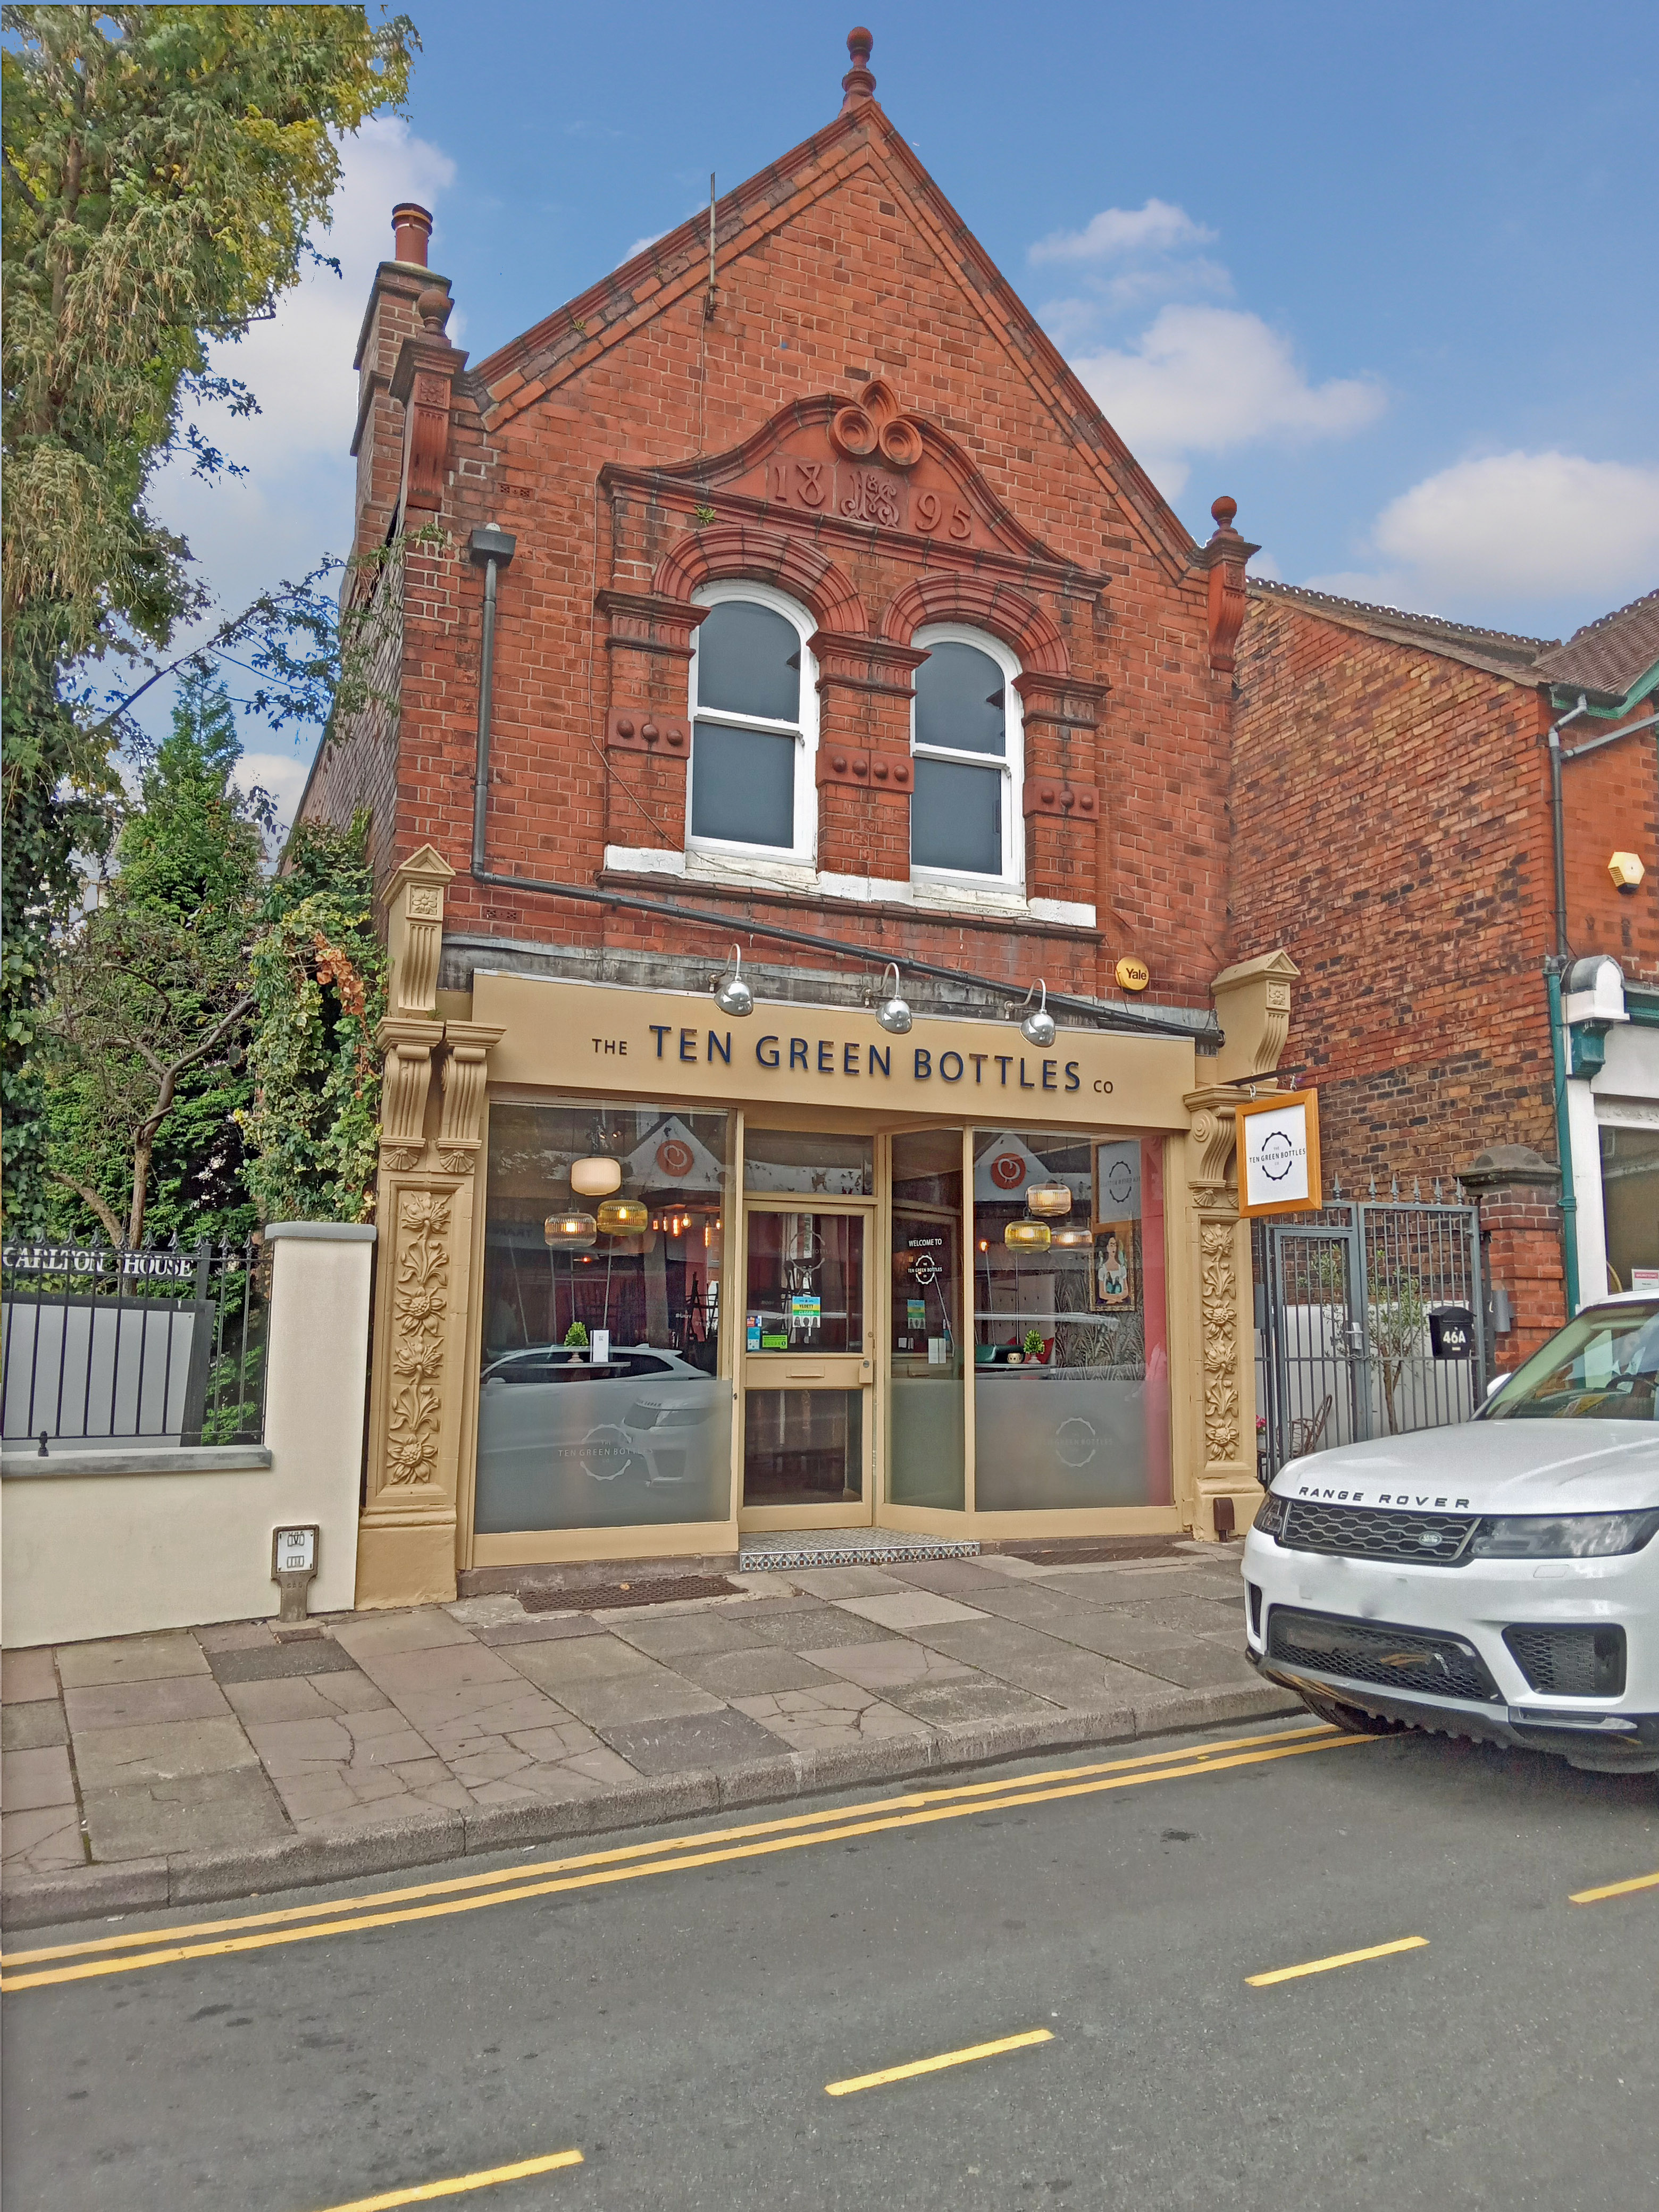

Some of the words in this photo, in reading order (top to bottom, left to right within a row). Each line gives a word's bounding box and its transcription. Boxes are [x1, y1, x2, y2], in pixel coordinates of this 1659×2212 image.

[1126, 968, 1146, 980] Yale
[592, 1038, 627, 1055] THE
[649, 1025, 731, 1063] TEN
[756, 1035, 891, 1077] GREEN
[914, 1049, 1080, 1091] BOTTLES
[1093, 1079, 1113, 1094] CO
[1281, 1148, 1305, 1158] BOTTLES
[123, 1253, 193, 1276] HOUSE
[1443, 1330, 1466, 1344] 46A
[579, 1448, 610, 1456] GREEN
[1299, 1487, 1364, 1501] RANGE
[1379, 1494, 1470, 1509] ROVER
